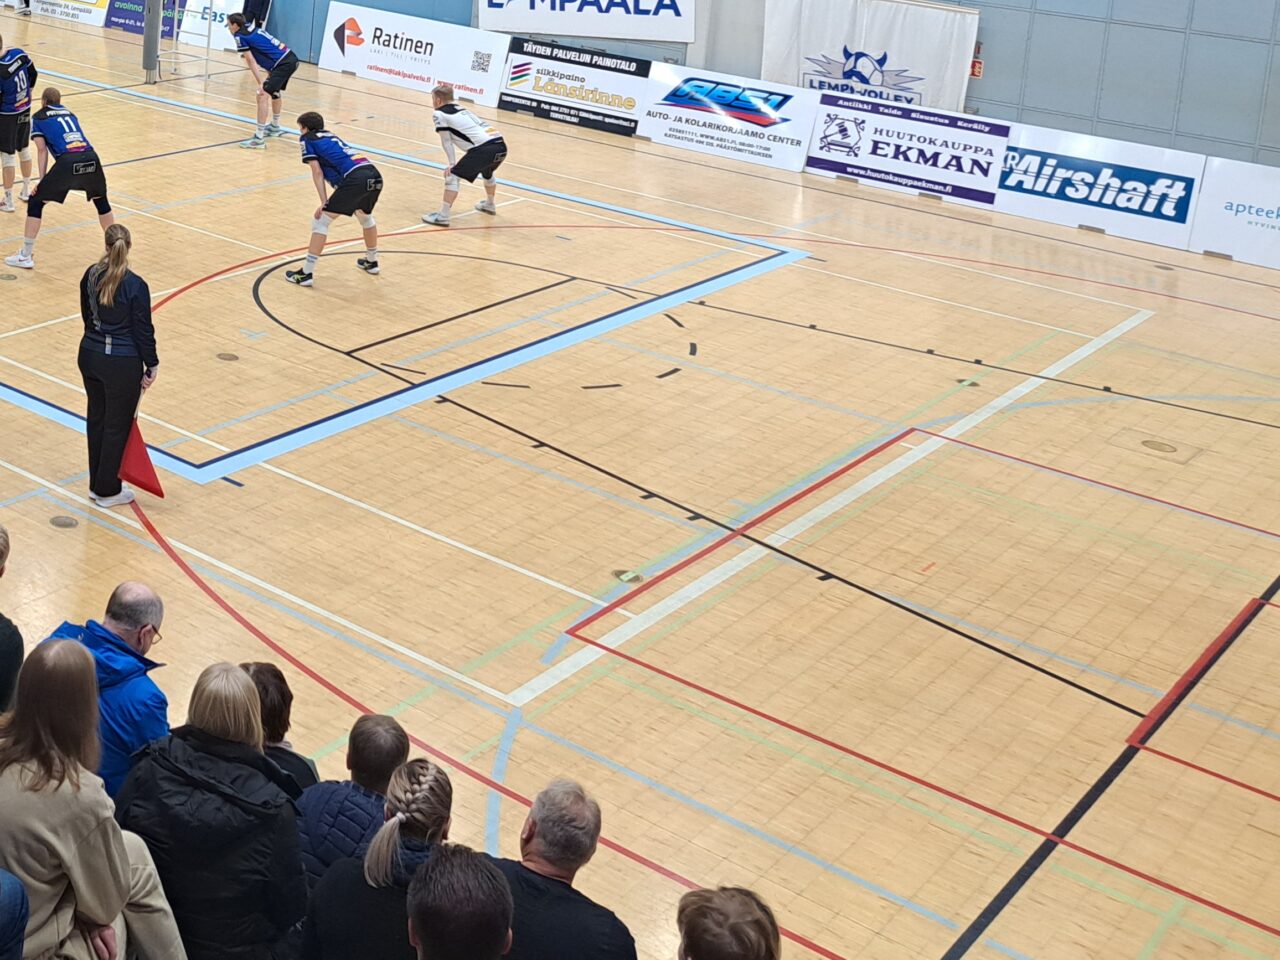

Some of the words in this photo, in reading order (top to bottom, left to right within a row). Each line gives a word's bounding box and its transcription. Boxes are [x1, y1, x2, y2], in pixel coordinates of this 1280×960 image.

[372, 27, 435, 56] Ratinen
[523, 41, 552, 56] TÄYDEN
[552, 48, 592, 64] PALVELUN
[592, 55, 637, 72] PAINOTALO
[14, 70, 27, 92] 10
[535, 67, 586, 84] silkkipaino
[532, 75, 637, 110] Länsirinne
[57, 116, 77, 133] 11
[646, 109, 672, 121] AUTO-
[672, 115, 683, 124] JA
[684, 117, 766, 140] KOLARIKORJAAMO
[766, 134, 802, 147] CENTER
[837, 98, 872, 111] Antiikki
[878, 106, 903, 117] Taide
[910, 111, 950, 125] Sisustus
[956, 119, 992, 133] Keräily
[872, 127, 995, 158] HUUTOKAUPPA
[868, 139, 993, 178] EKMAN
[846, 165, 953, 194] www.huutokauppaekman.fi
[1004, 154, 1187, 217] Airshaft
